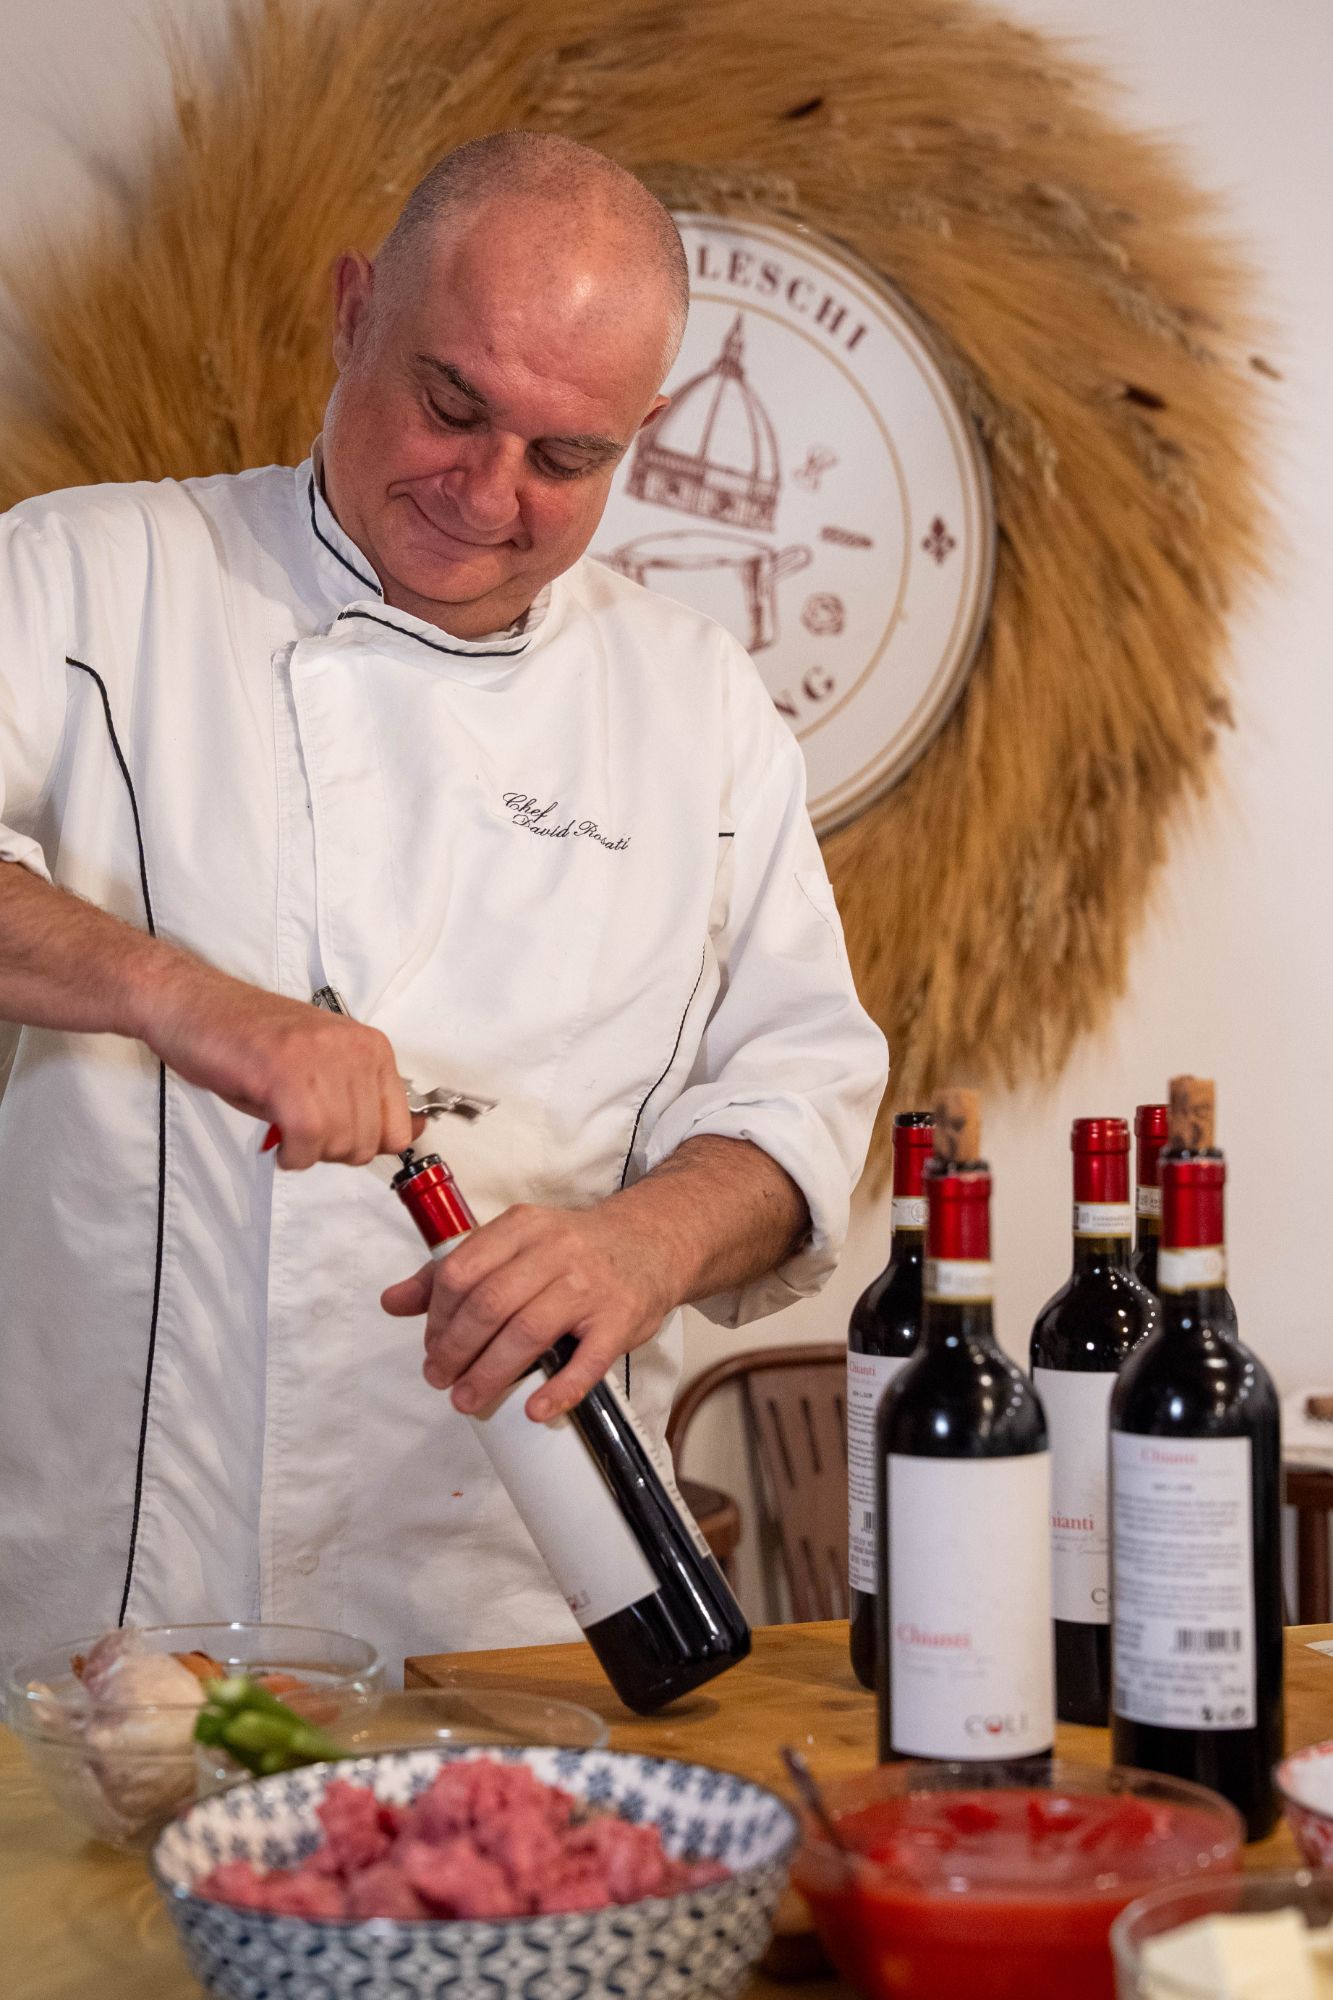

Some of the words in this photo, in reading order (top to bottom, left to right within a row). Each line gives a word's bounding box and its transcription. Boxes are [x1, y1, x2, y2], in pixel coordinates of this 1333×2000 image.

[502, 792, 558, 823] Chef
[512, 814, 576, 838] David
[573, 820, 632, 850] Rosati
